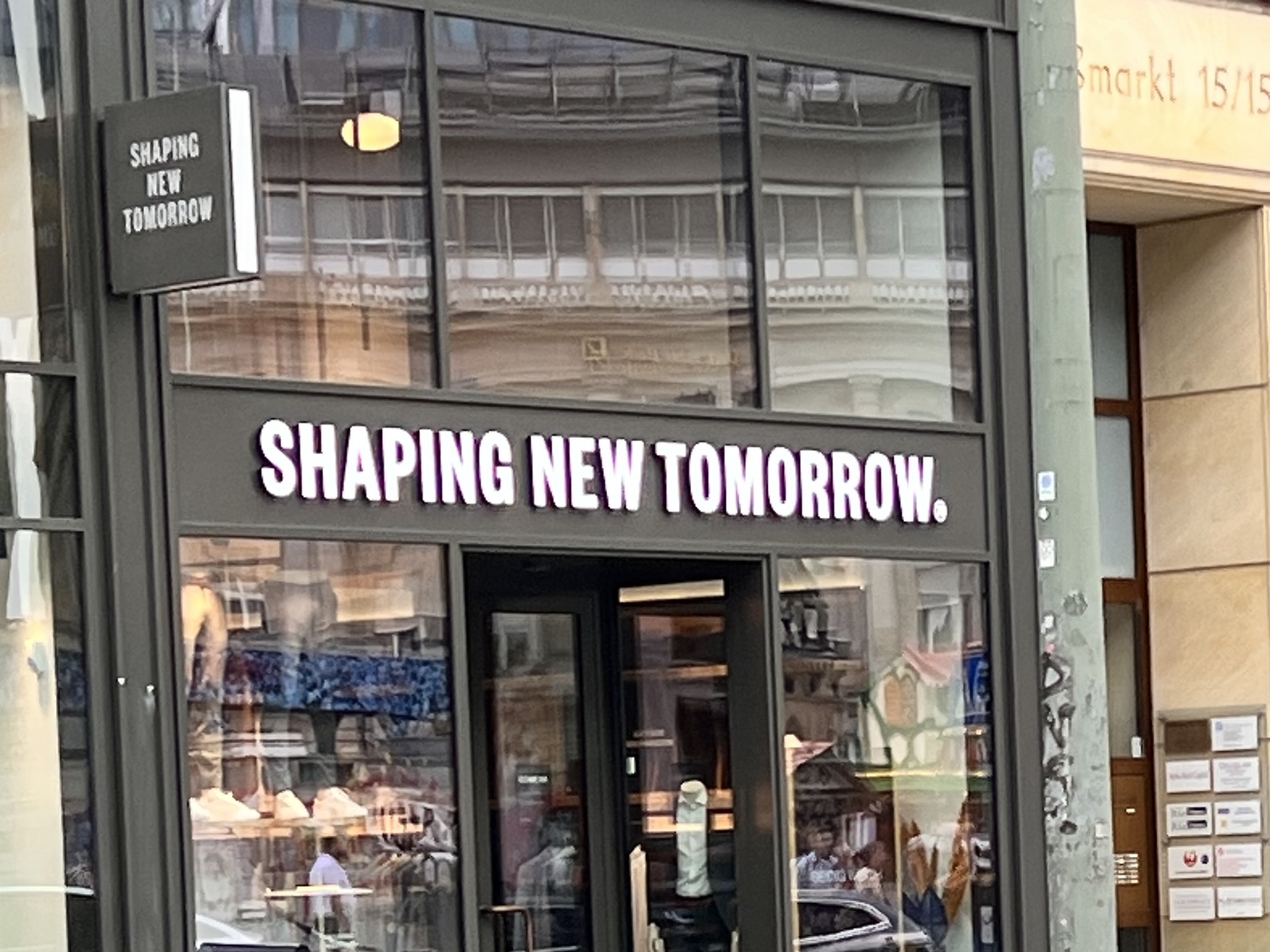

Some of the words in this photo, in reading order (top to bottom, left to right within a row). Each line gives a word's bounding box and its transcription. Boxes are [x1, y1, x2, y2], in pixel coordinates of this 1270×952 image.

[130, 132, 199, 168] SHAPING
[146, 168, 181, 197] NEW
[123, 195, 212, 234] TOMORROW
[259, 418, 514, 506] SHAPING
[530, 433, 645, 511] NEW
